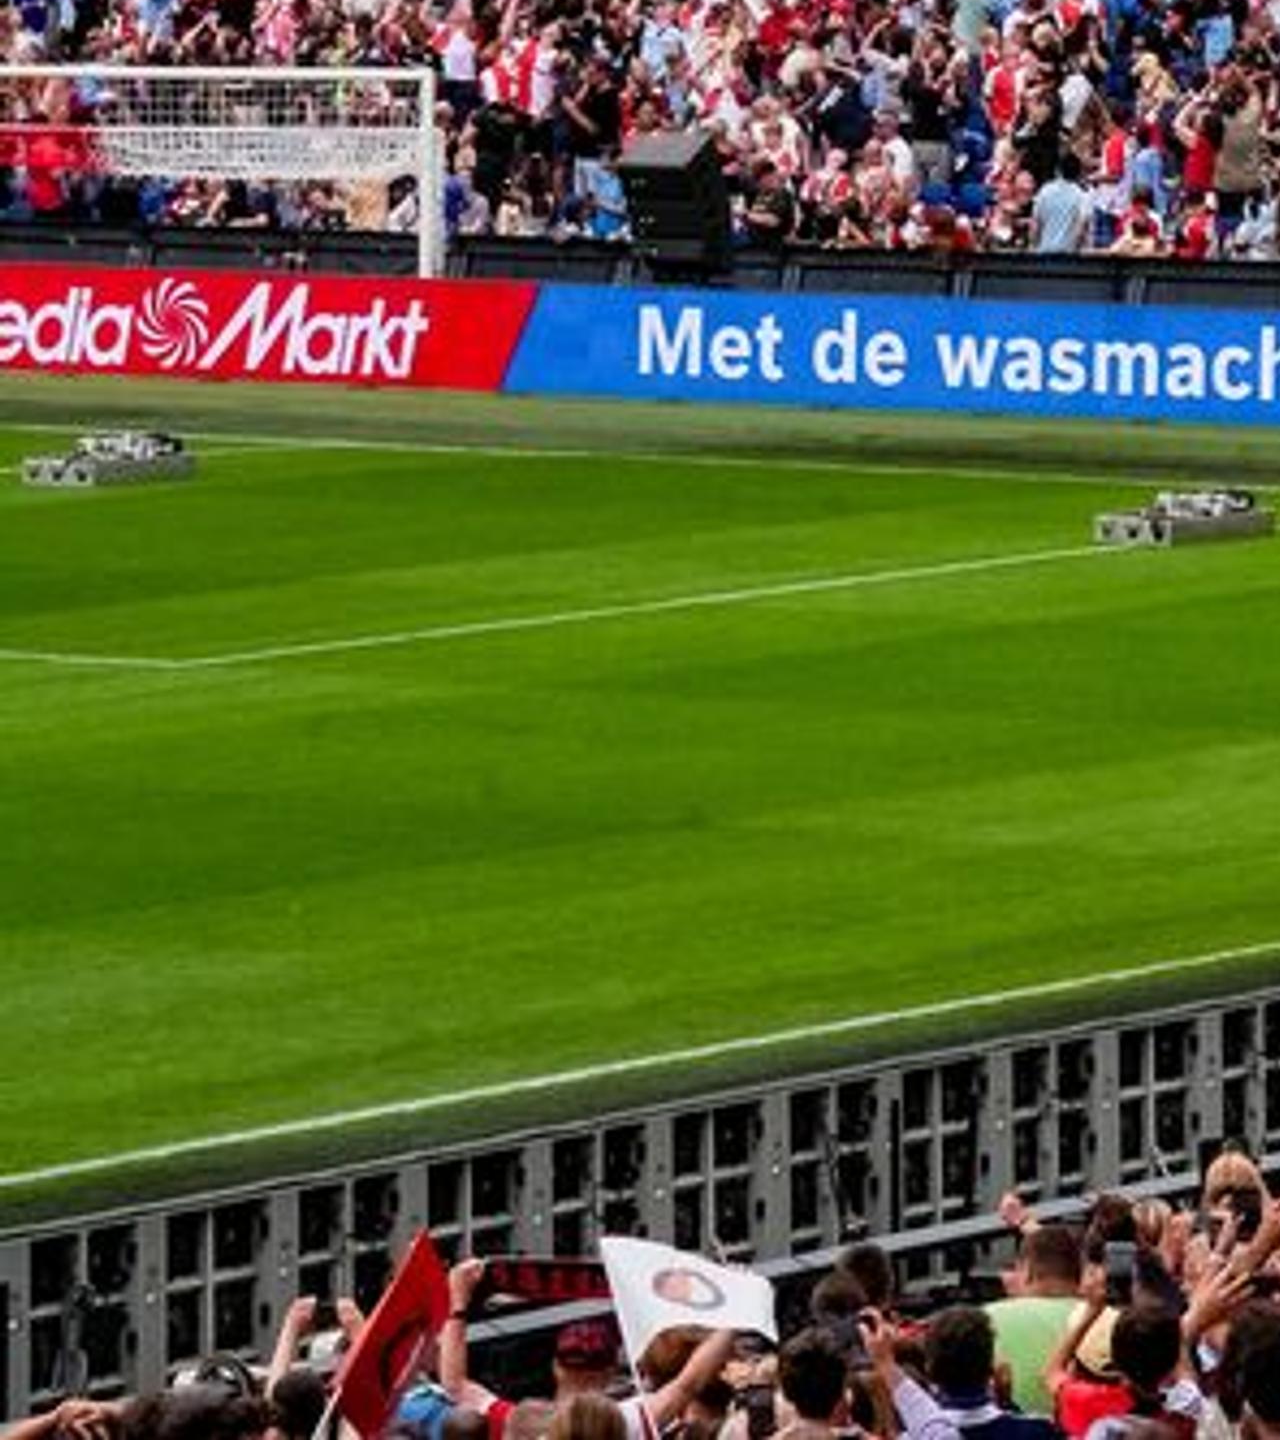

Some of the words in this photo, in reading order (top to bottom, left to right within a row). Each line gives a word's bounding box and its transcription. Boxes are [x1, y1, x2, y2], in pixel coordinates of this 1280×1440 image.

[197, 282, 429, 378] Markt
[637, 305, 784, 381] Met
[812, 310, 908, 386] de
